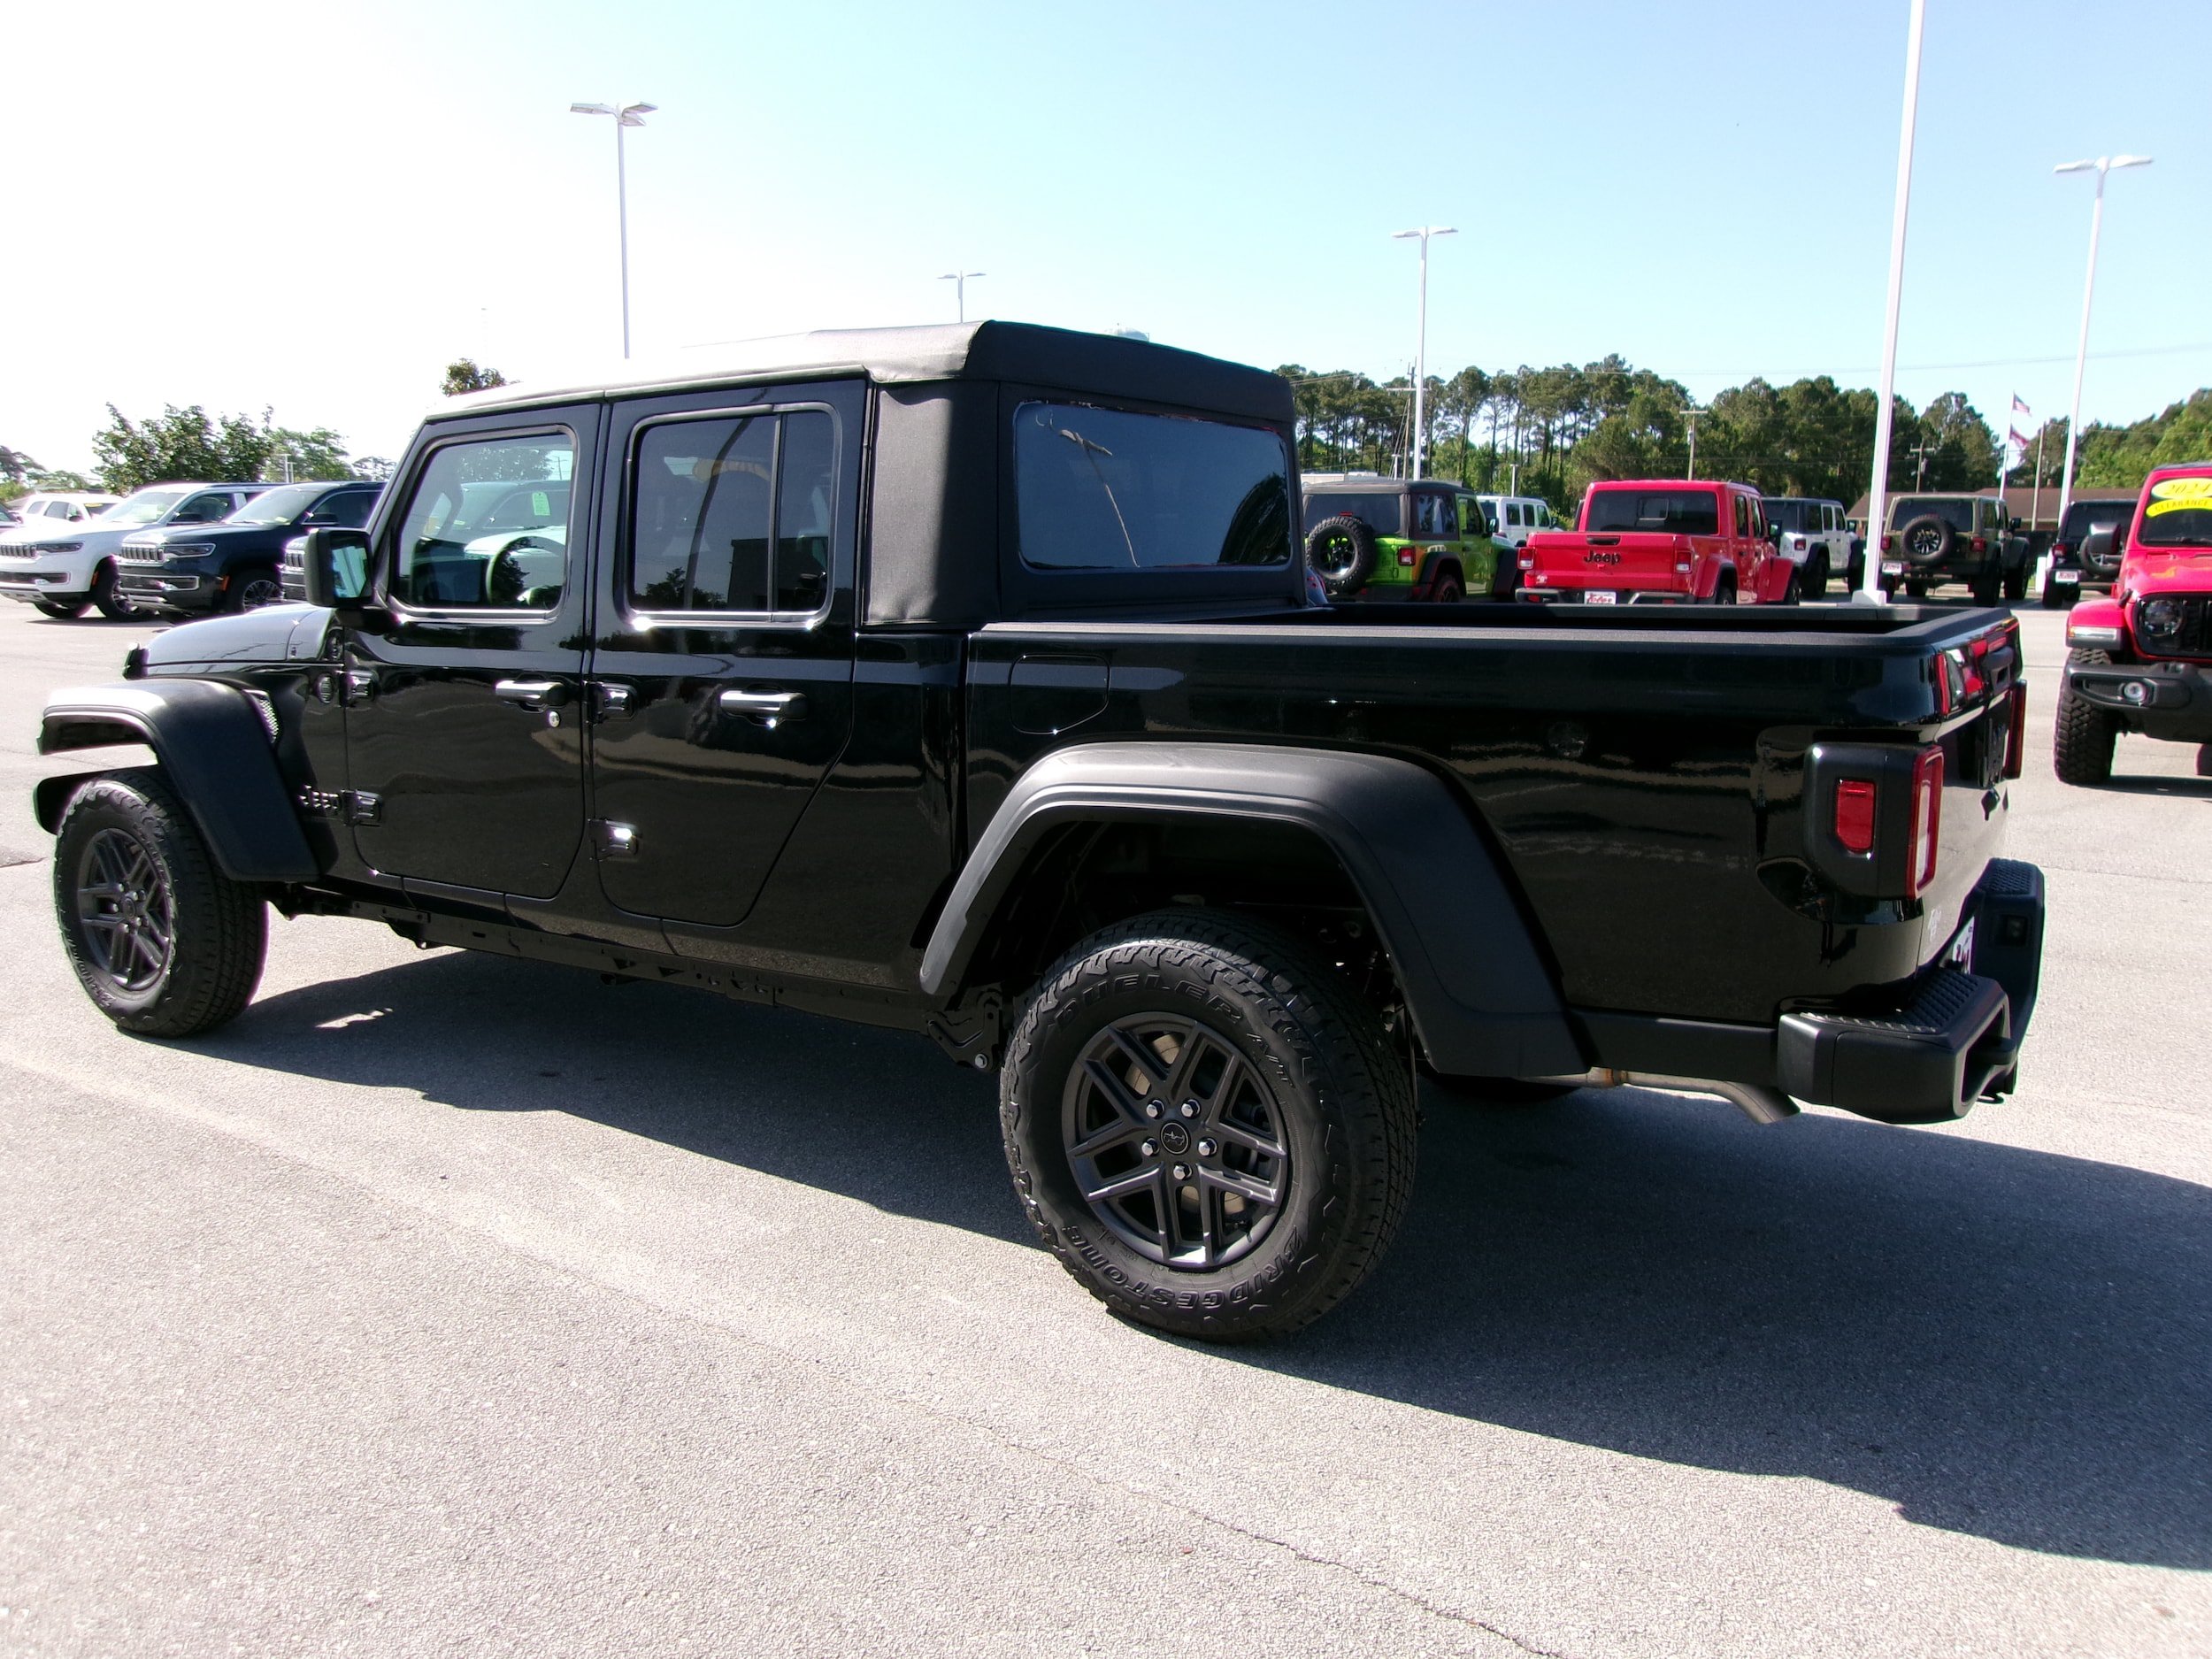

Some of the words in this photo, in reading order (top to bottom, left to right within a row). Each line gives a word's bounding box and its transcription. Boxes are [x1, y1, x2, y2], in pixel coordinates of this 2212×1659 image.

[2164, 483, 2211, 495] 2024
[2154, 499, 2208, 511] CLEARANCE
[1584, 549, 1621, 565] Jeep
[1054, 972, 1243, 1025] DUELER
[1060, 1225, 1304, 1310] BRIDGESTONE
